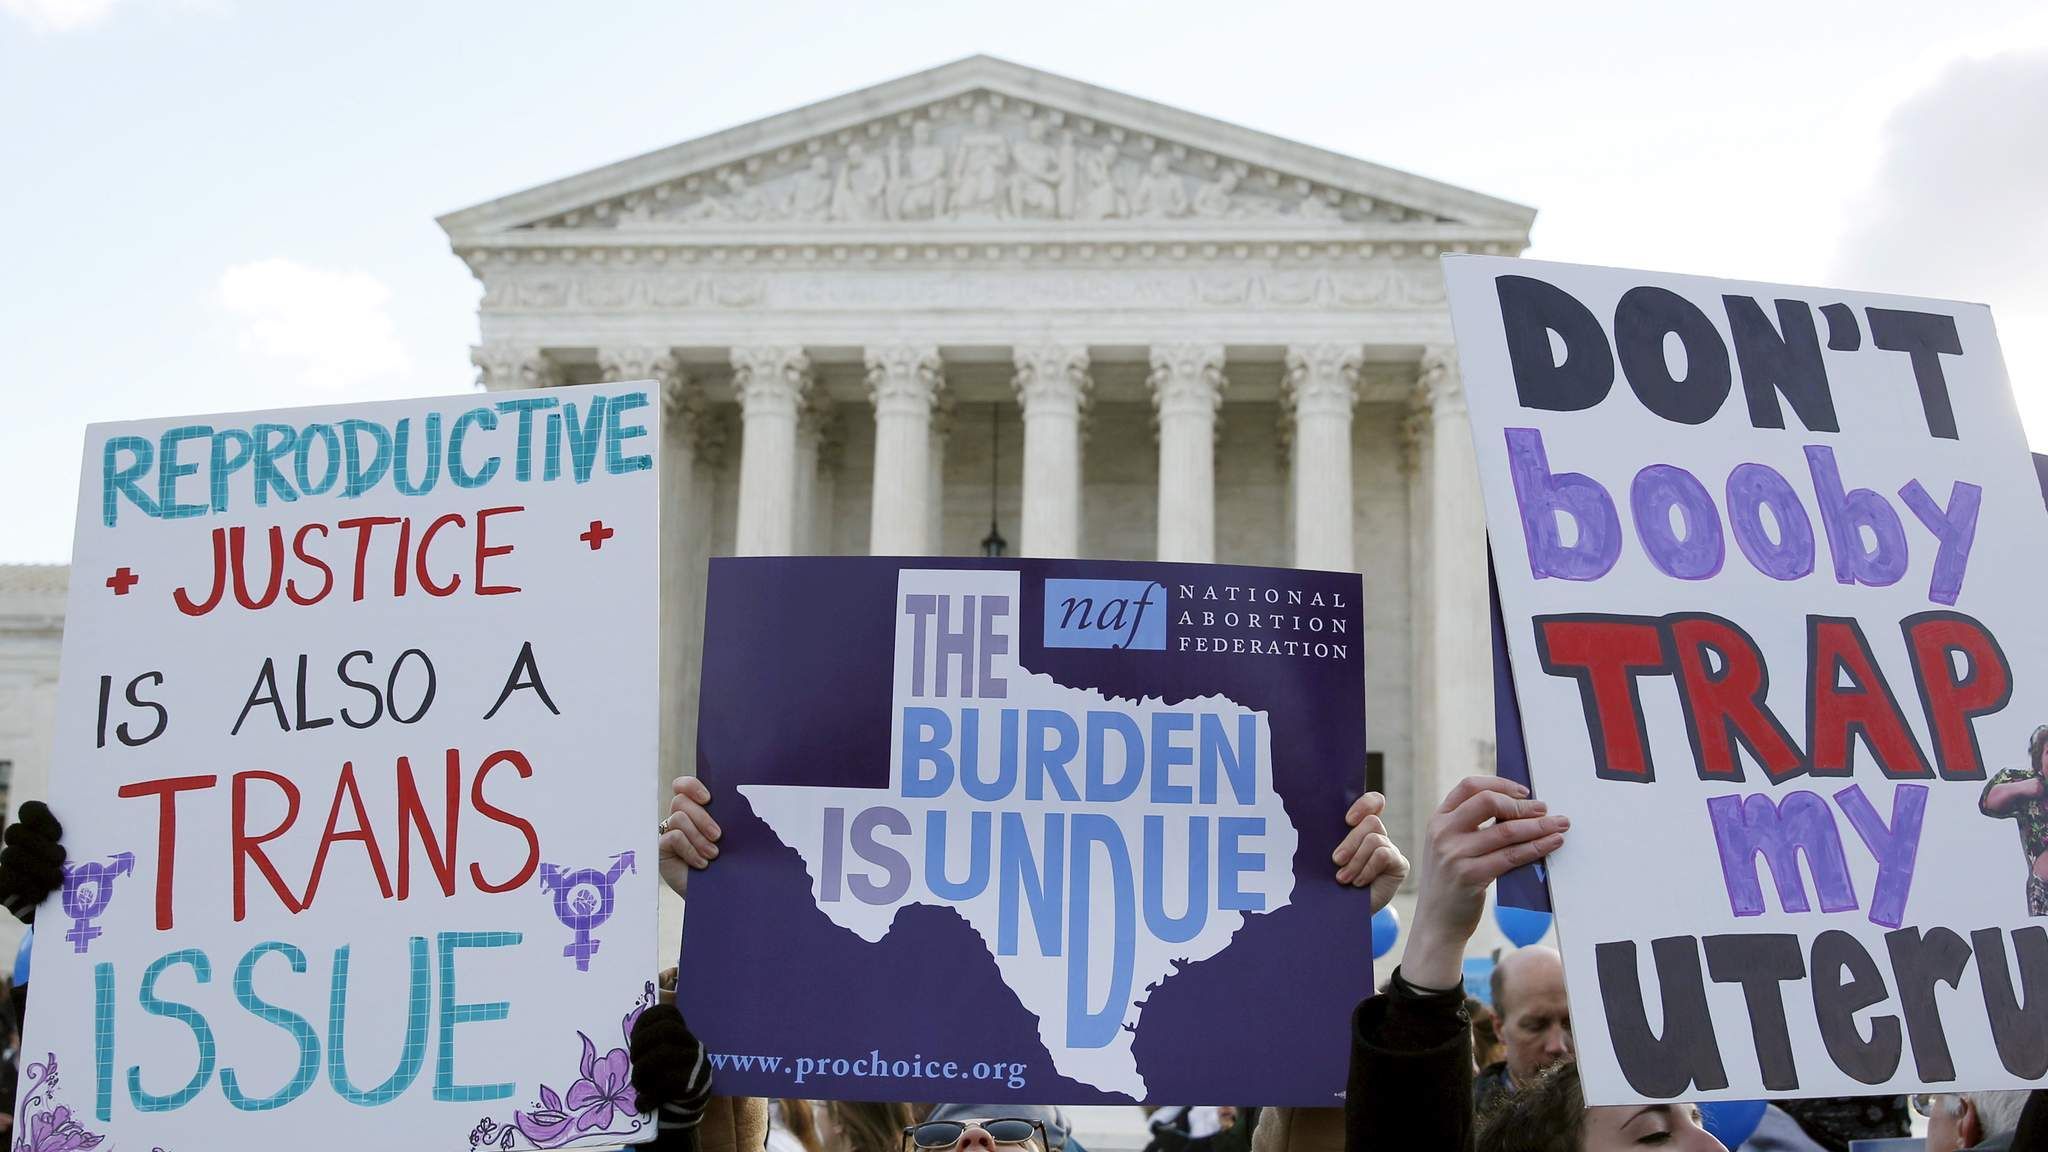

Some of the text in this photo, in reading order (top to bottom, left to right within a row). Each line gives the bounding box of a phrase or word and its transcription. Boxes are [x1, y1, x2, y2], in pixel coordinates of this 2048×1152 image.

[1495, 275, 1963, 440] DON'T
[103, 391, 653, 527] REPRODUCTIVE
[172, 505, 525, 617] JUSTICE
[1504, 428, 1982, 606] booby
[905, 595, 1009, 699] THE
[1060, 581, 1167, 650] naf
[1178, 610, 1347, 634] ABORTION
[1178, 636, 1348, 660] FEDERATION
[1179, 584, 1346, 608] NATIONAL
[97, 641, 560, 749] IS ALSO A
[1532, 611, 2014, 786] TRAP
[901, 707, 1257, 806] BURDEN
[118, 748, 540, 931] TRANS
[1706, 783, 1929, 929] my
[819, 807, 1266, 1048] IS UNDUE
[94, 931, 524, 1123] ISSUE
[707, 1049, 1028, 1088] www.prochoice.org
